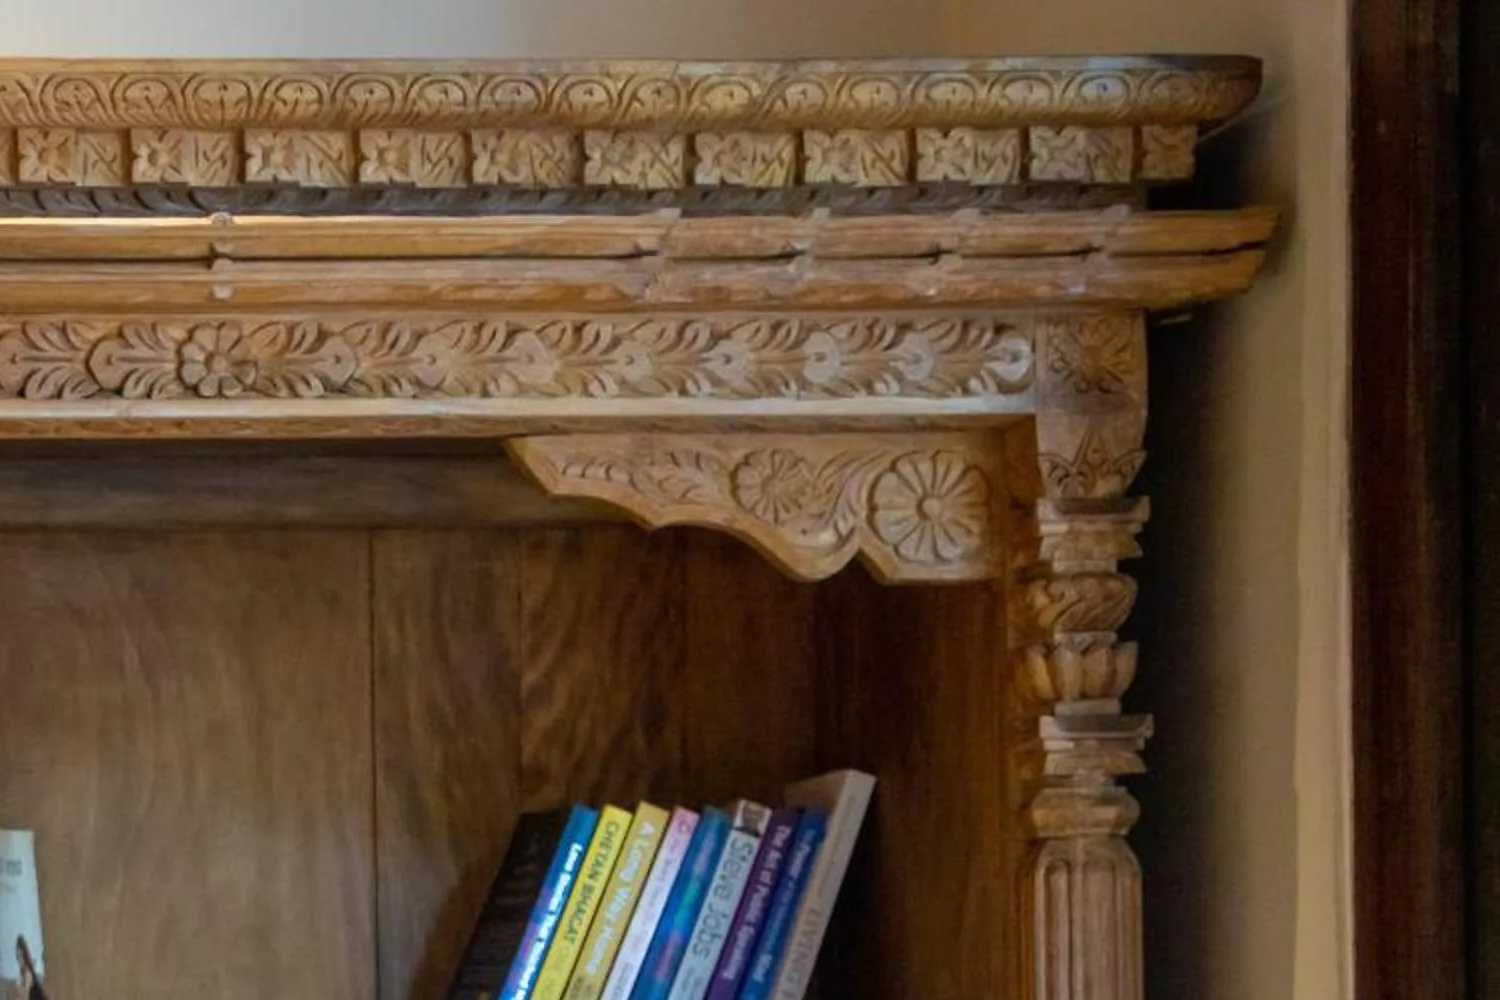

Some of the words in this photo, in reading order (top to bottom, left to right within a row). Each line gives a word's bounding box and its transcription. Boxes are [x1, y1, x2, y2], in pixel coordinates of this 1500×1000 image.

[639, 820, 653, 837] A
[770, 823, 789, 848] The
[562, 842, 582, 871] Love
[585, 819, 620, 883] CHETAN
[618, 839, 646, 882] Long
[711, 836, 754, 903] Steve
[762, 847, 781, 870] Art
[757, 869, 773, 884] of
[562, 881, 596, 944] BHAGAT
[603, 883, 629, 922] Way
[742, 883, 768, 924] Public
[691, 902, 731, 961] Jobs
